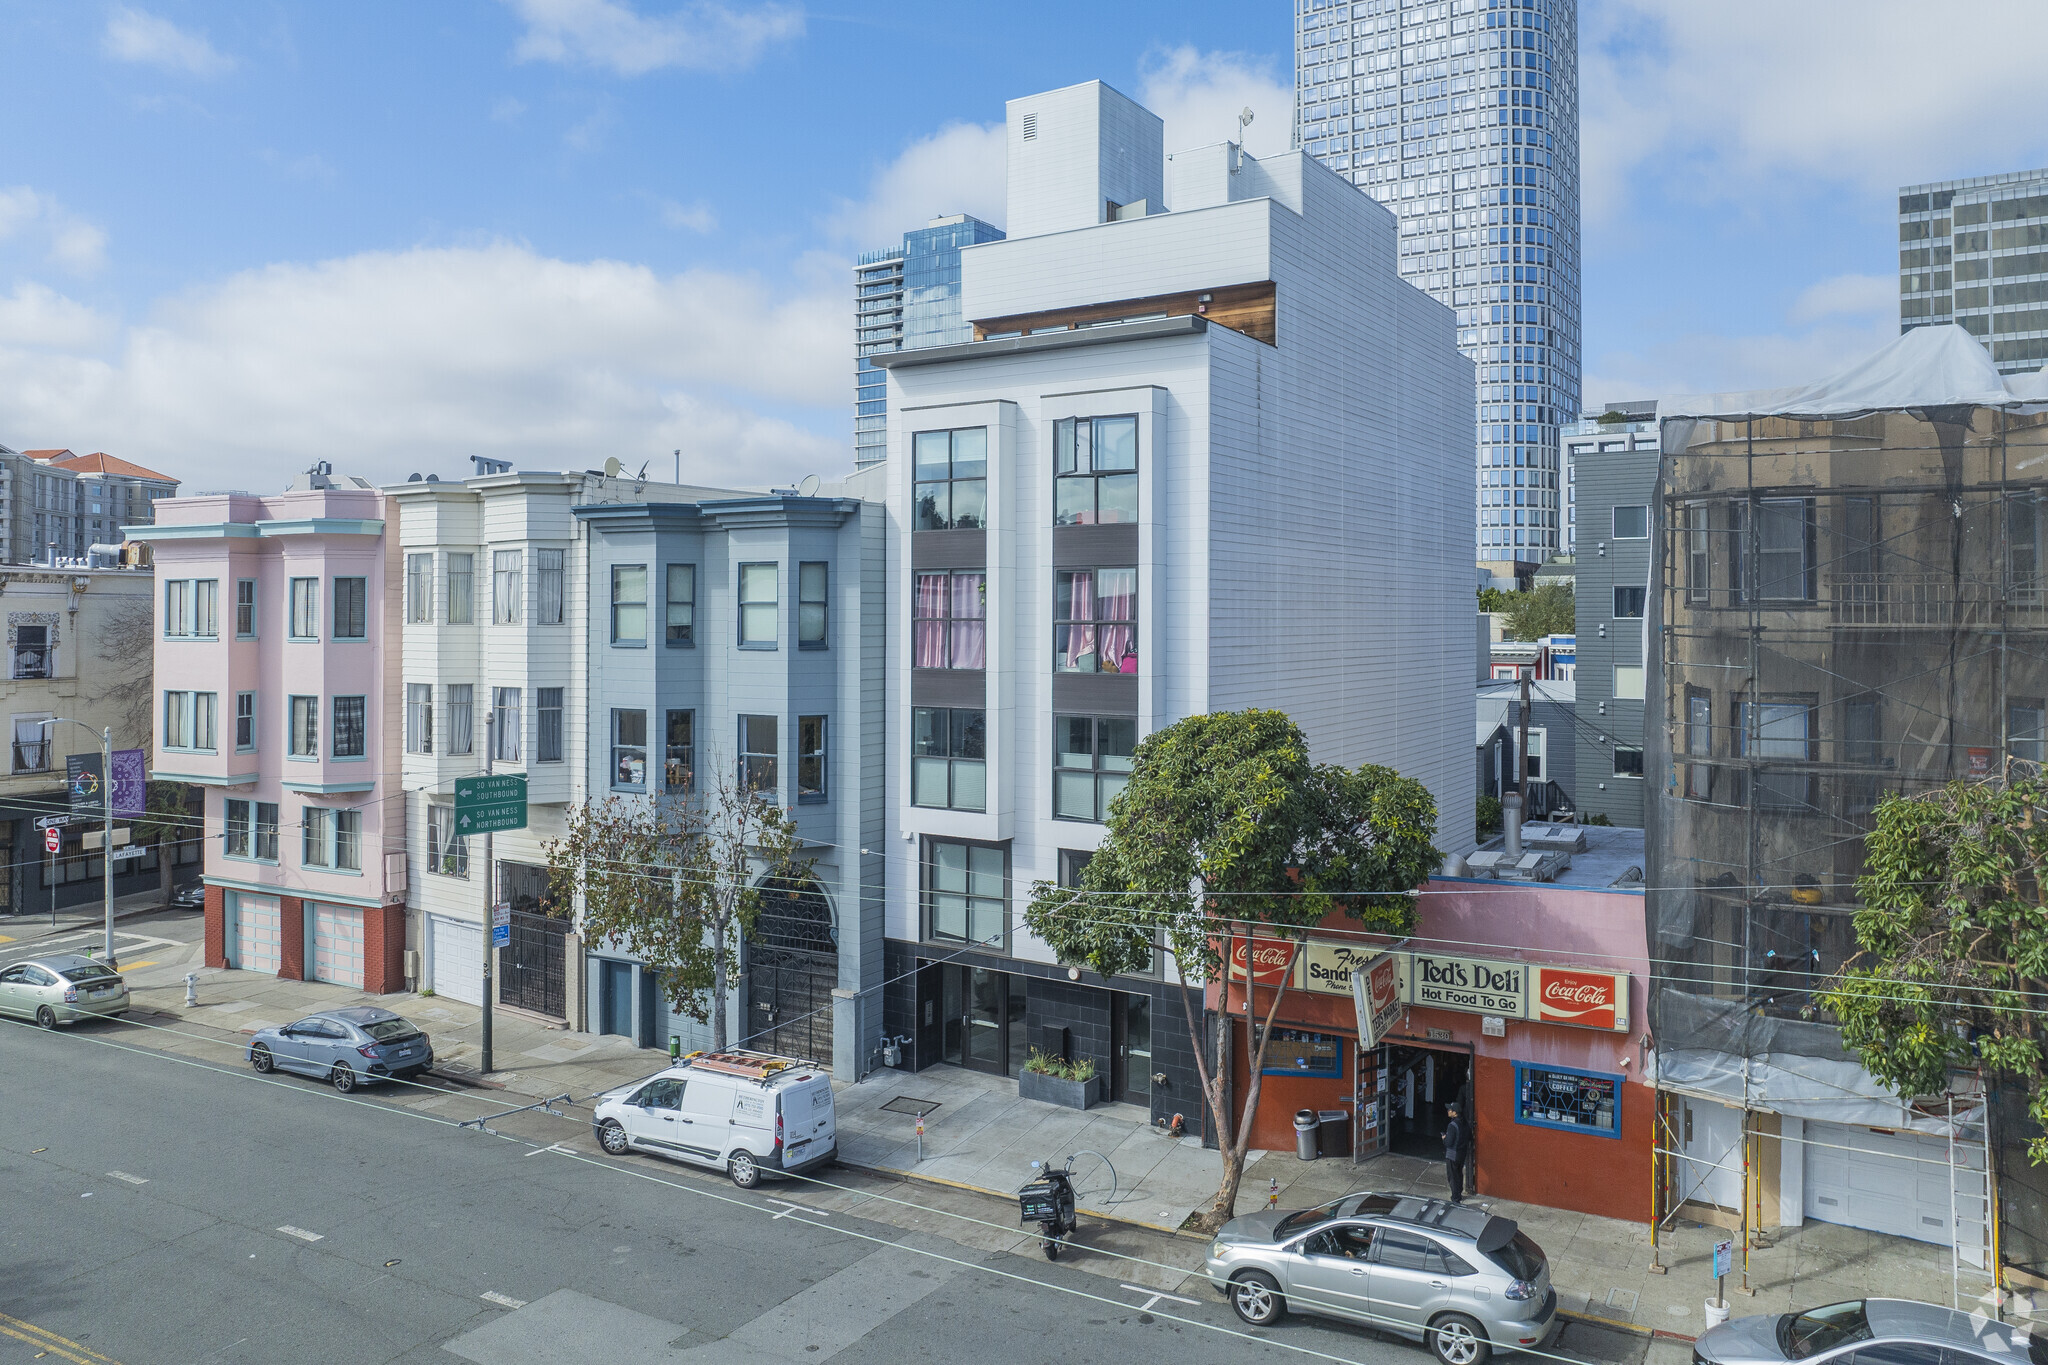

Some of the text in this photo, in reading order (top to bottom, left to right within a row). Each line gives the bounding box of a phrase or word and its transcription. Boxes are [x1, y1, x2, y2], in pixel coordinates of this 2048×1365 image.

[476, 778, 518, 789] SO VAN NESS
[476, 789, 518, 800] SOUTHBOUND
[476, 807, 518, 819] SO VAN NESS
[476, 817, 518, 829] NORTHBOUND
[115, 849, 143, 858] LAFAYETTE
[1417, 957, 1521, 993] Ted's Deli
[1325, 980, 1347, 991] Phone
[1422, 988, 1517, 1010] Hot Food To Go
[1545, 981, 1608, 1005] Coca-Cola
[1384, 997, 1400, 1020] MARKET
[1552, 1083, 1573, 1092] COFFEE
